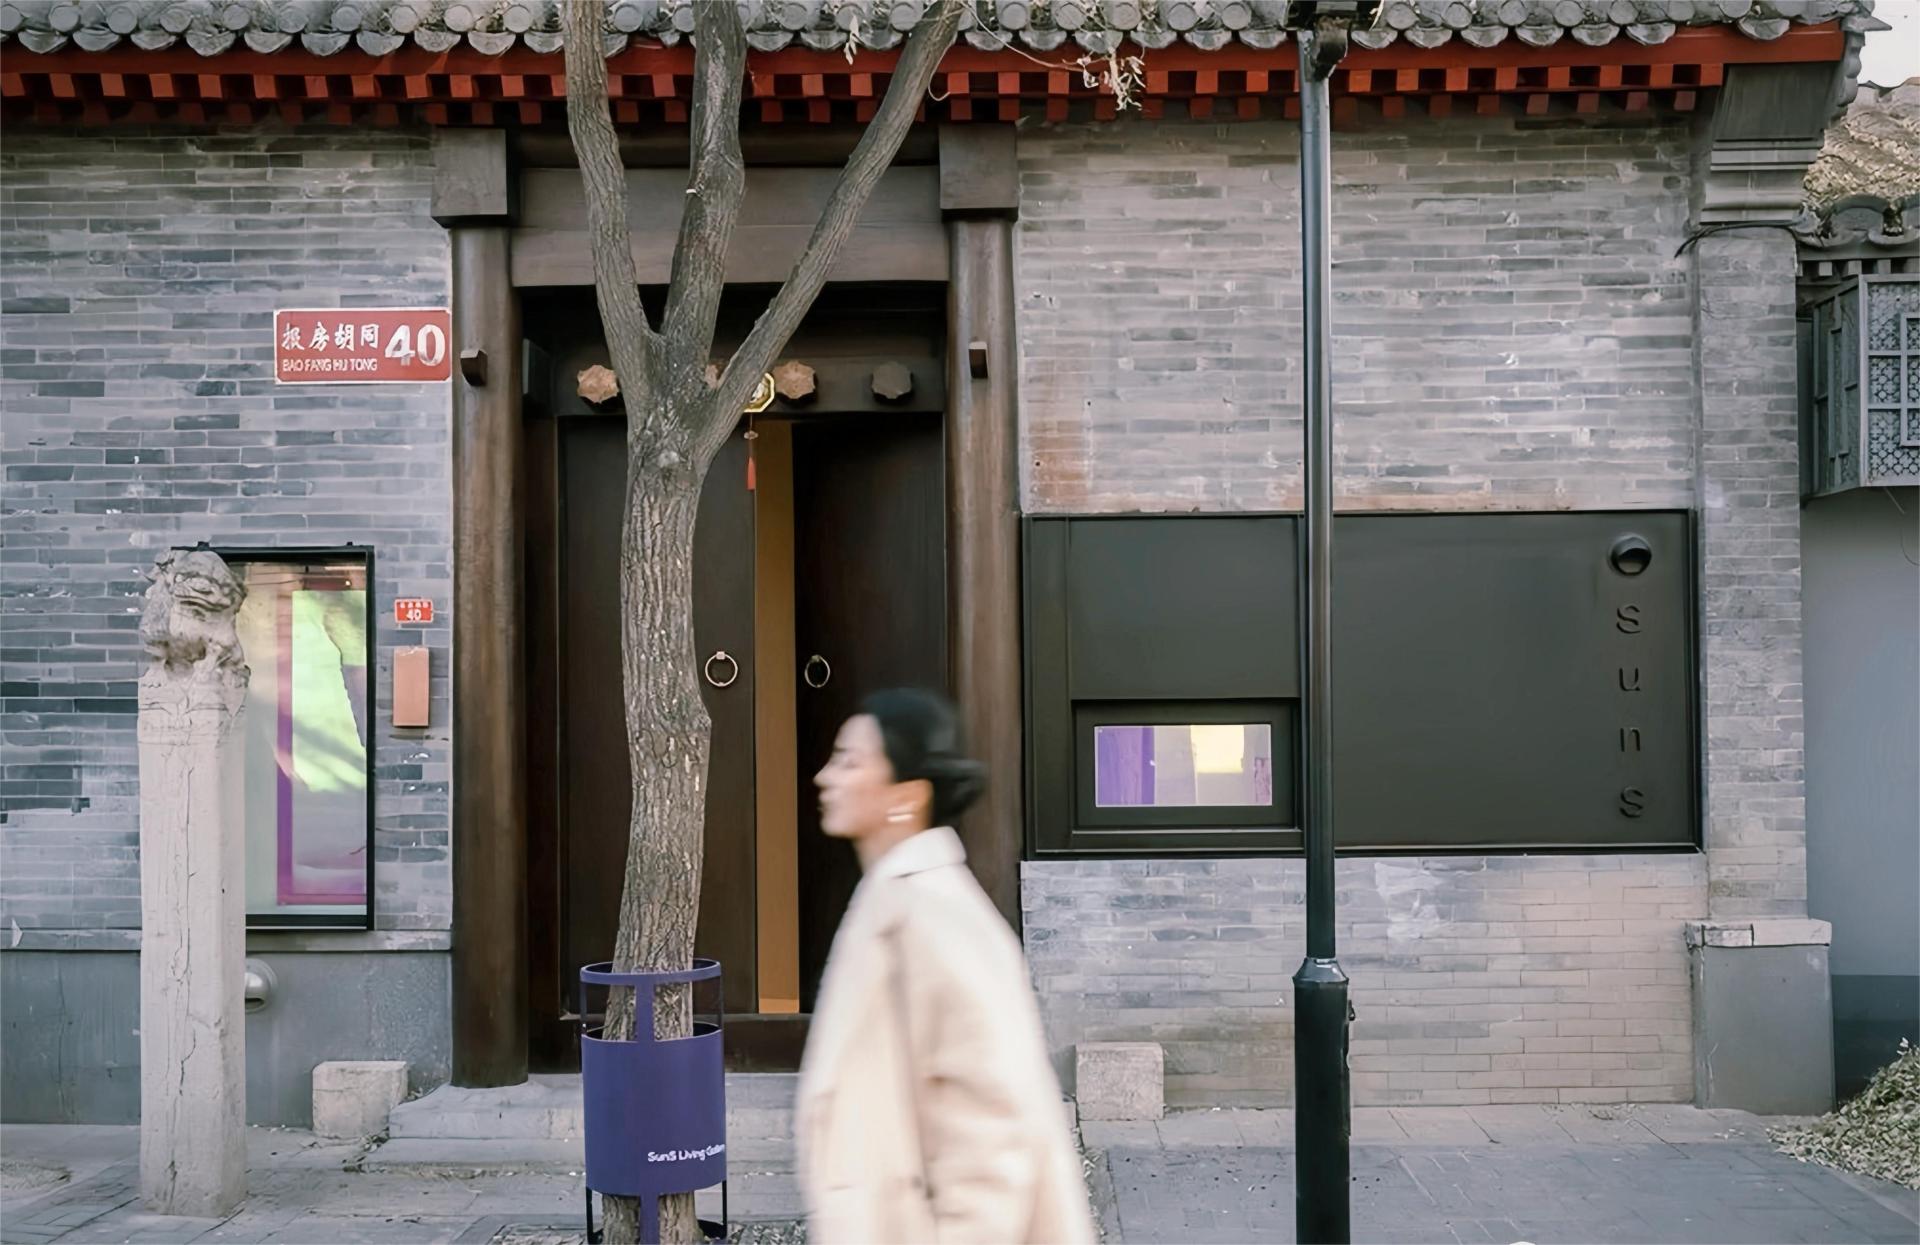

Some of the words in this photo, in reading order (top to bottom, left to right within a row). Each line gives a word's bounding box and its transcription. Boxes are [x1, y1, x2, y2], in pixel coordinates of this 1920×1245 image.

[385, 324, 446, 367] 40
[282, 358, 304, 372] BAO
[304, 358, 332, 372] FANG
[349, 358, 378, 372] TONG
[406, 609, 422, 621] 40
